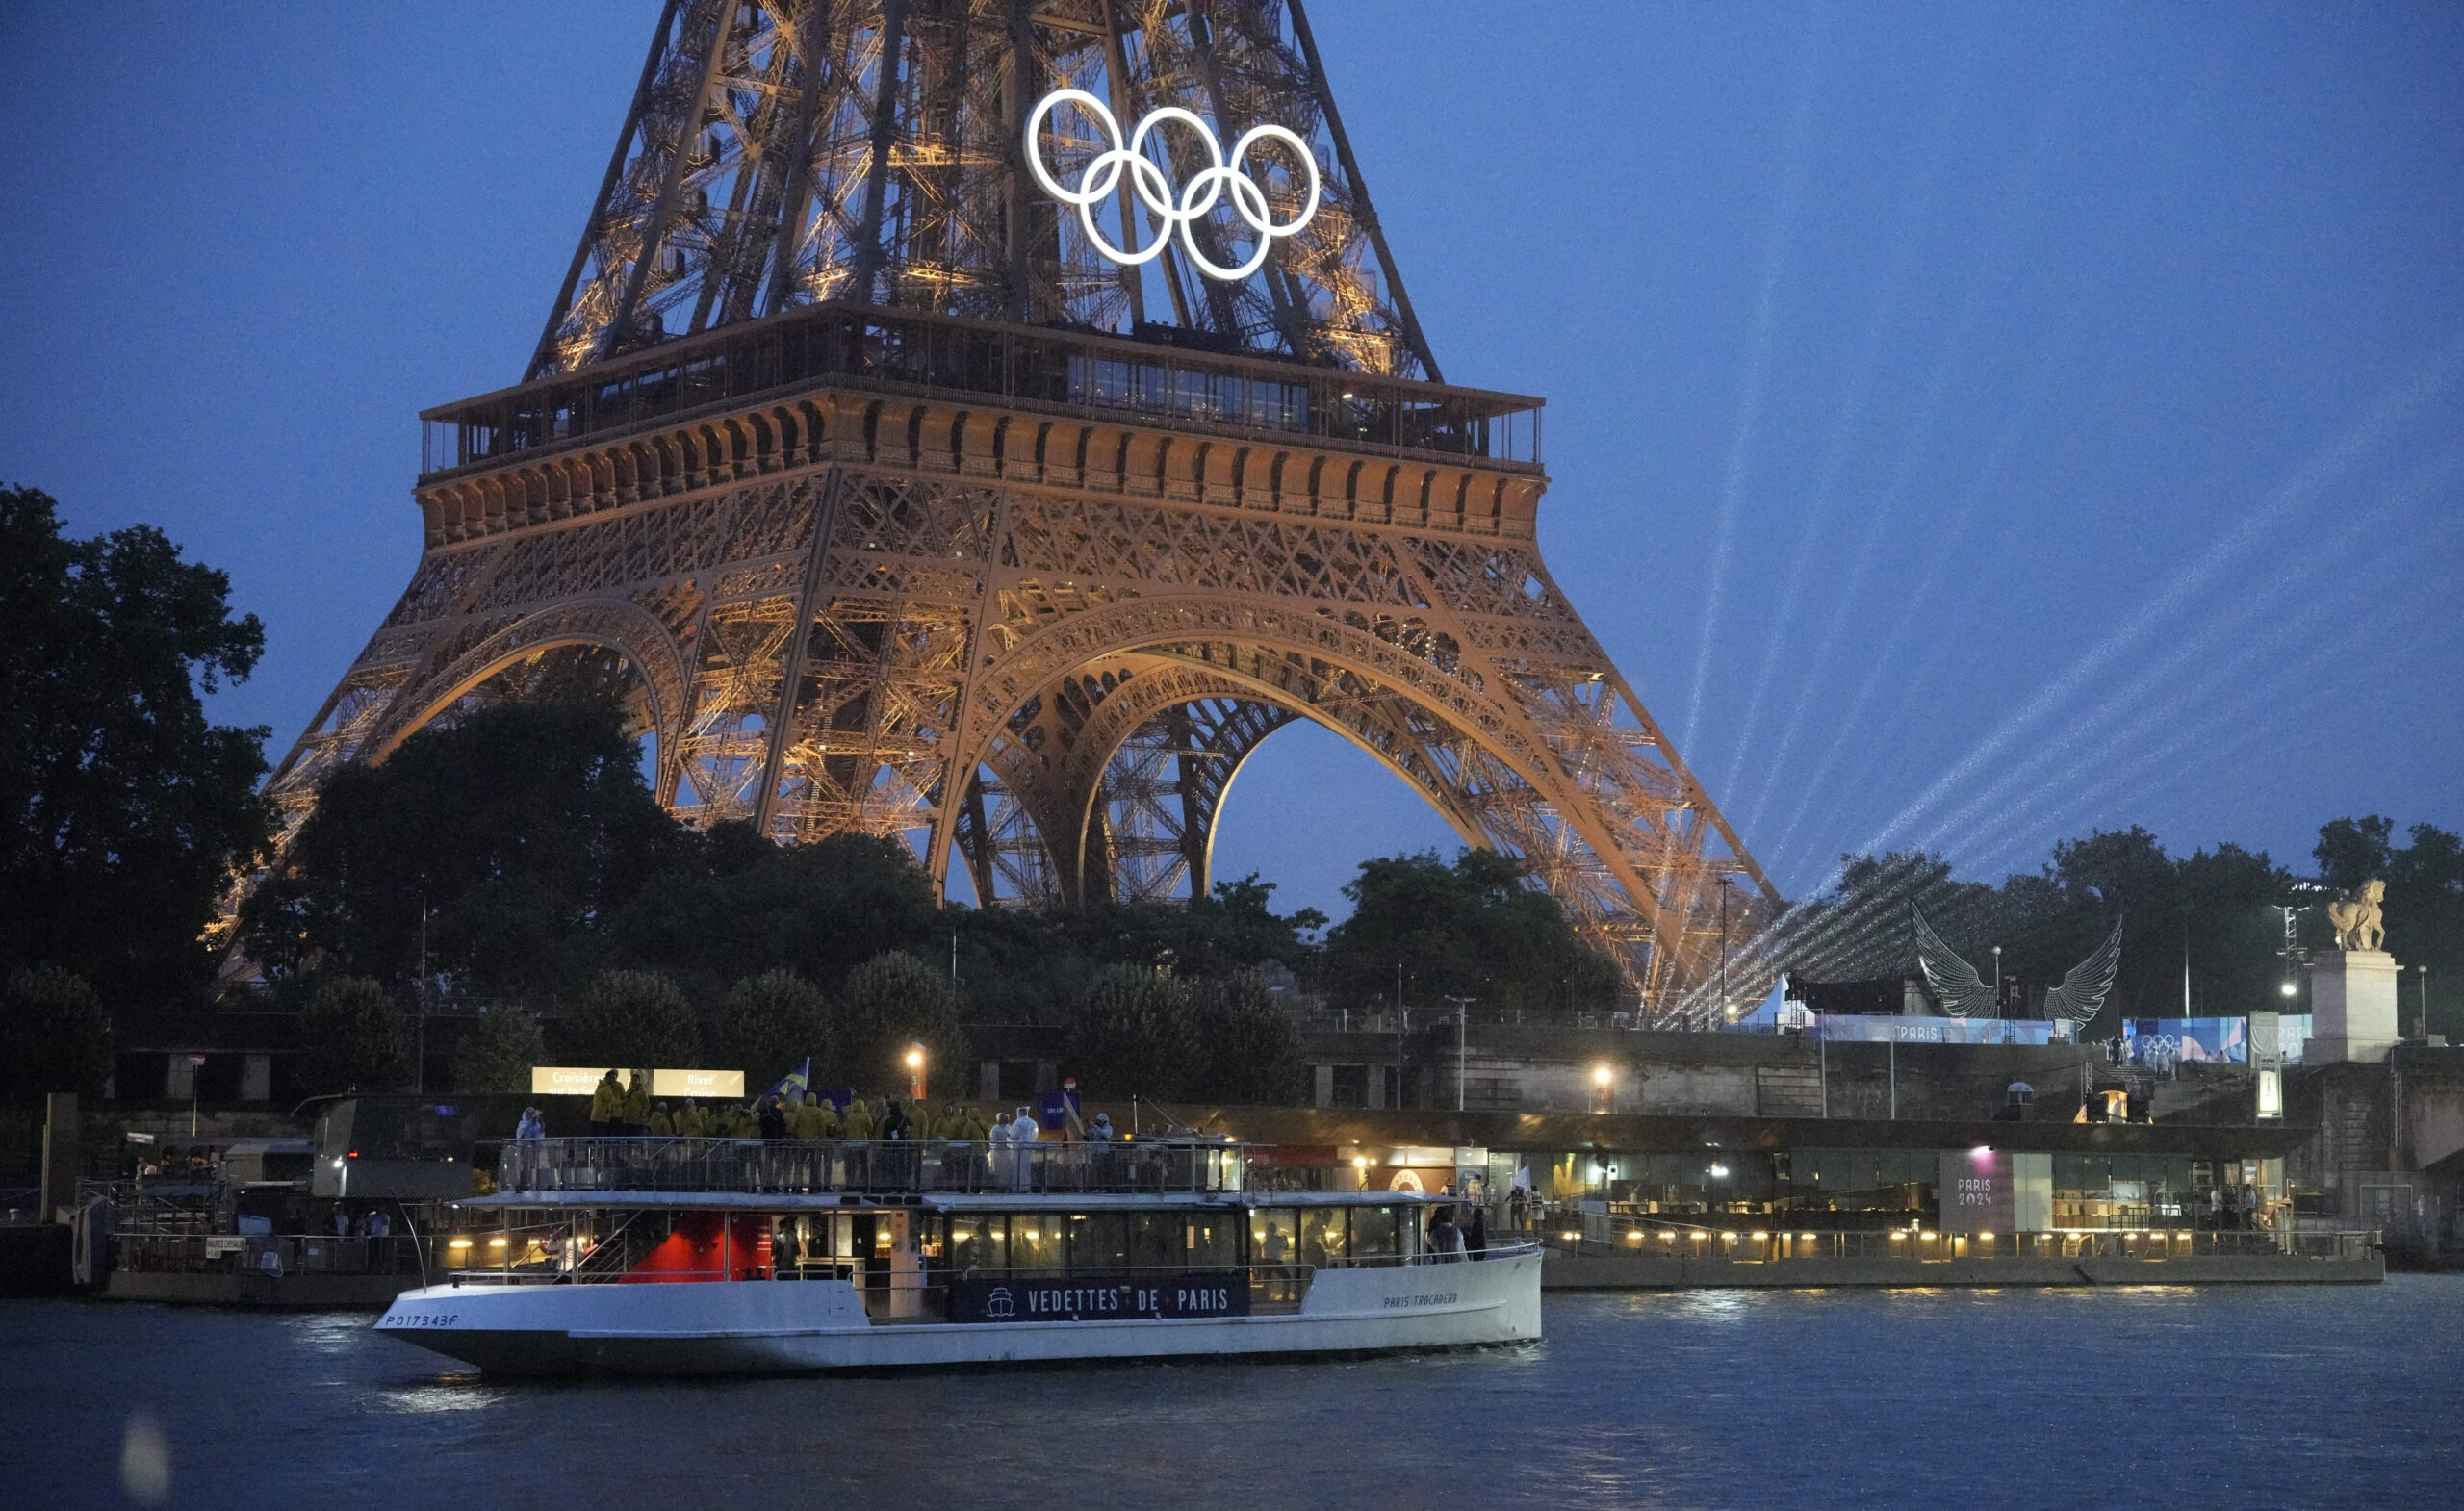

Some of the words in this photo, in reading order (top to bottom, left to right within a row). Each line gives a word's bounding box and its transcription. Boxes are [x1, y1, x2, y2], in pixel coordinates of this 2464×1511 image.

[1901, 1026, 1938, 1040] PARIS
[687, 1074, 714, 1085] River
[1958, 1179, 1991, 1191] PARIS
[1958, 1193, 1991, 1206] 2024
[1028, 1289, 1119, 1312] VEDETTES
[1138, 1289, 1159, 1311] DE
[1178, 1288, 1228, 1310] PARIS
[1384, 1296, 1410, 1308] PARIS
[1414, 1293, 1458, 1306] TROCADERO
